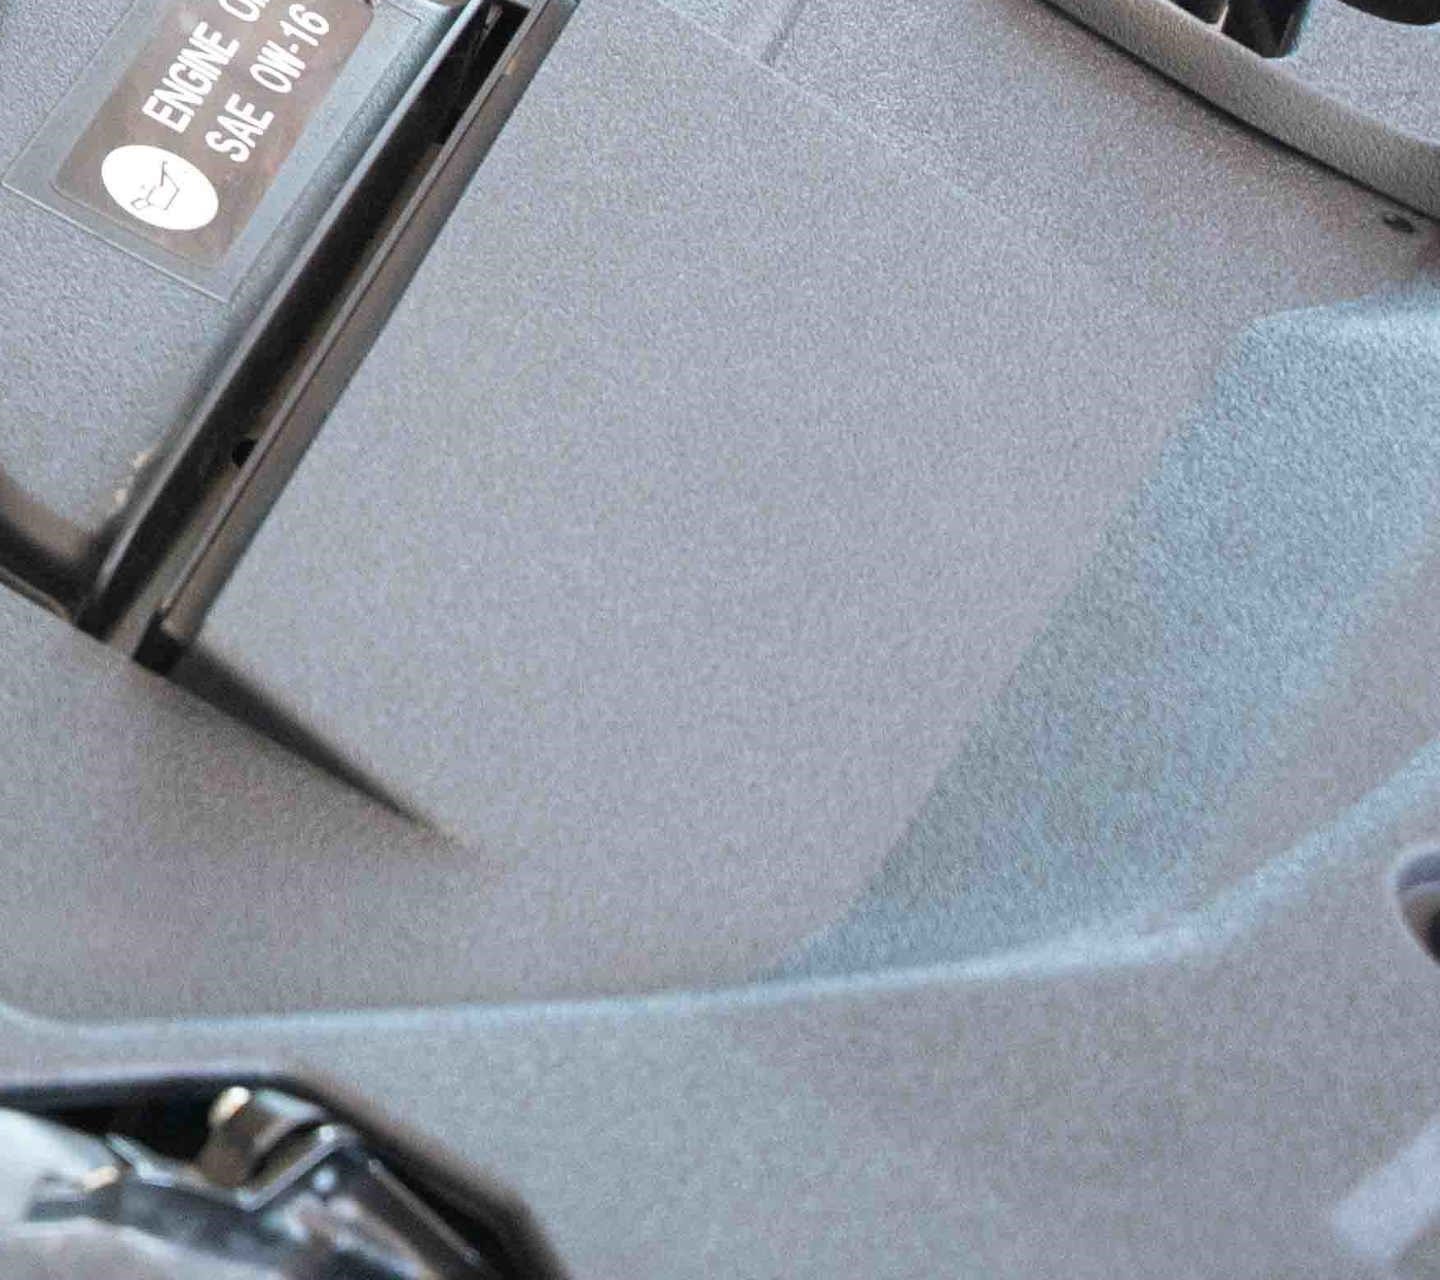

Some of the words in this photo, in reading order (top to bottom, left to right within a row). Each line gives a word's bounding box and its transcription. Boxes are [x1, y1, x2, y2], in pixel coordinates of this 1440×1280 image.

[142, 21, 240, 134] ENGINE
[204, 93, 275, 162] SAE
[249, 3, 330, 93] 0W-16
